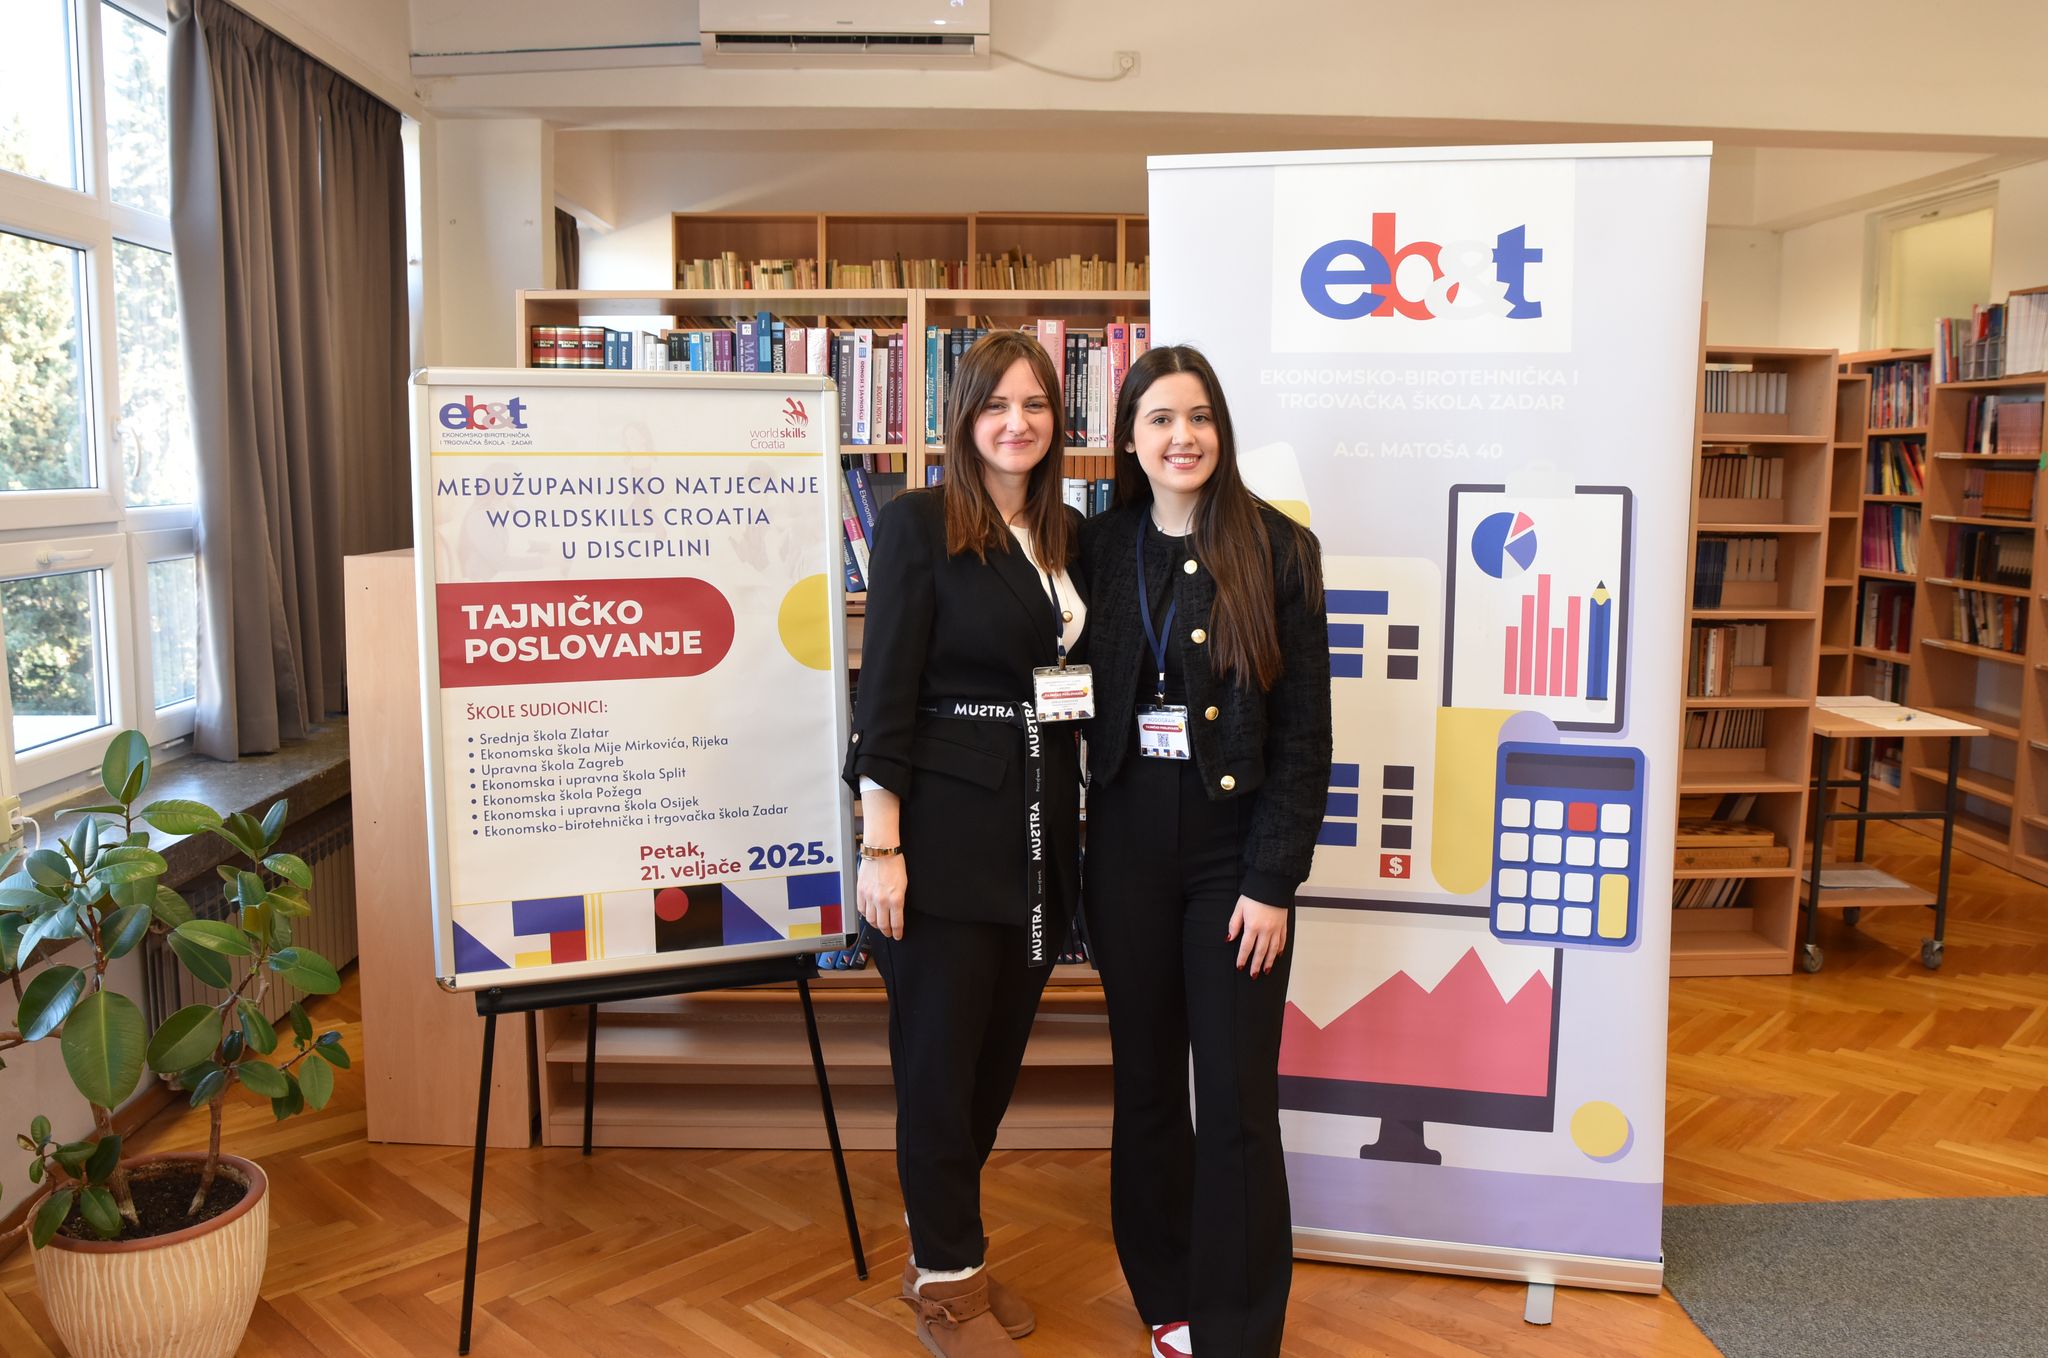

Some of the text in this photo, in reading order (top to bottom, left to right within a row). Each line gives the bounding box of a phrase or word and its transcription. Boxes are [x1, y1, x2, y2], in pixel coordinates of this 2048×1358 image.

[1260, 365, 1567, 387] EKONOMSKO-BIROTEHNIČKA
[1277, 389, 1565, 412] TRGOVAČKA ŠKOLA ZADAR
[750, 439, 785, 449] Croatia
[1381, 437, 1469, 460] MATOŠA
[1475, 443, 1502, 460] 40
[438, 472, 819, 497] MEĐUŽUPANIJSKO NATJECANJE
[486, 507, 769, 528] WORLDSKILLS CROATIA
[562, 540, 710, 559] U DISCIPLINI
[461, 595, 643, 629] TAJNIČKO
[465, 630, 702, 664] POSLOVANJE
[467, 701, 608, 720] ŠKOLE SUDIONICI:
[480, 727, 609, 745] Srednja škola Zlatar
[481, 735, 728, 761] Ekonomska škola Mije Mirkovića, Rijeka
[481, 756, 624, 779] Upravna škola Zagreb
[482, 767, 686, 791] Ekonomska i upravna škola Split
[483, 785, 642, 806] Ekonomska škola Požega
[484, 796, 698, 822] Ekonomska i upravna škola Osijek
[485, 803, 788, 837] Ekonomsko-birotehnička i trgovačka škola Zadar
[640, 841, 705, 861] Petak,
[641, 841, 834, 881] 21. veljače 2025.
